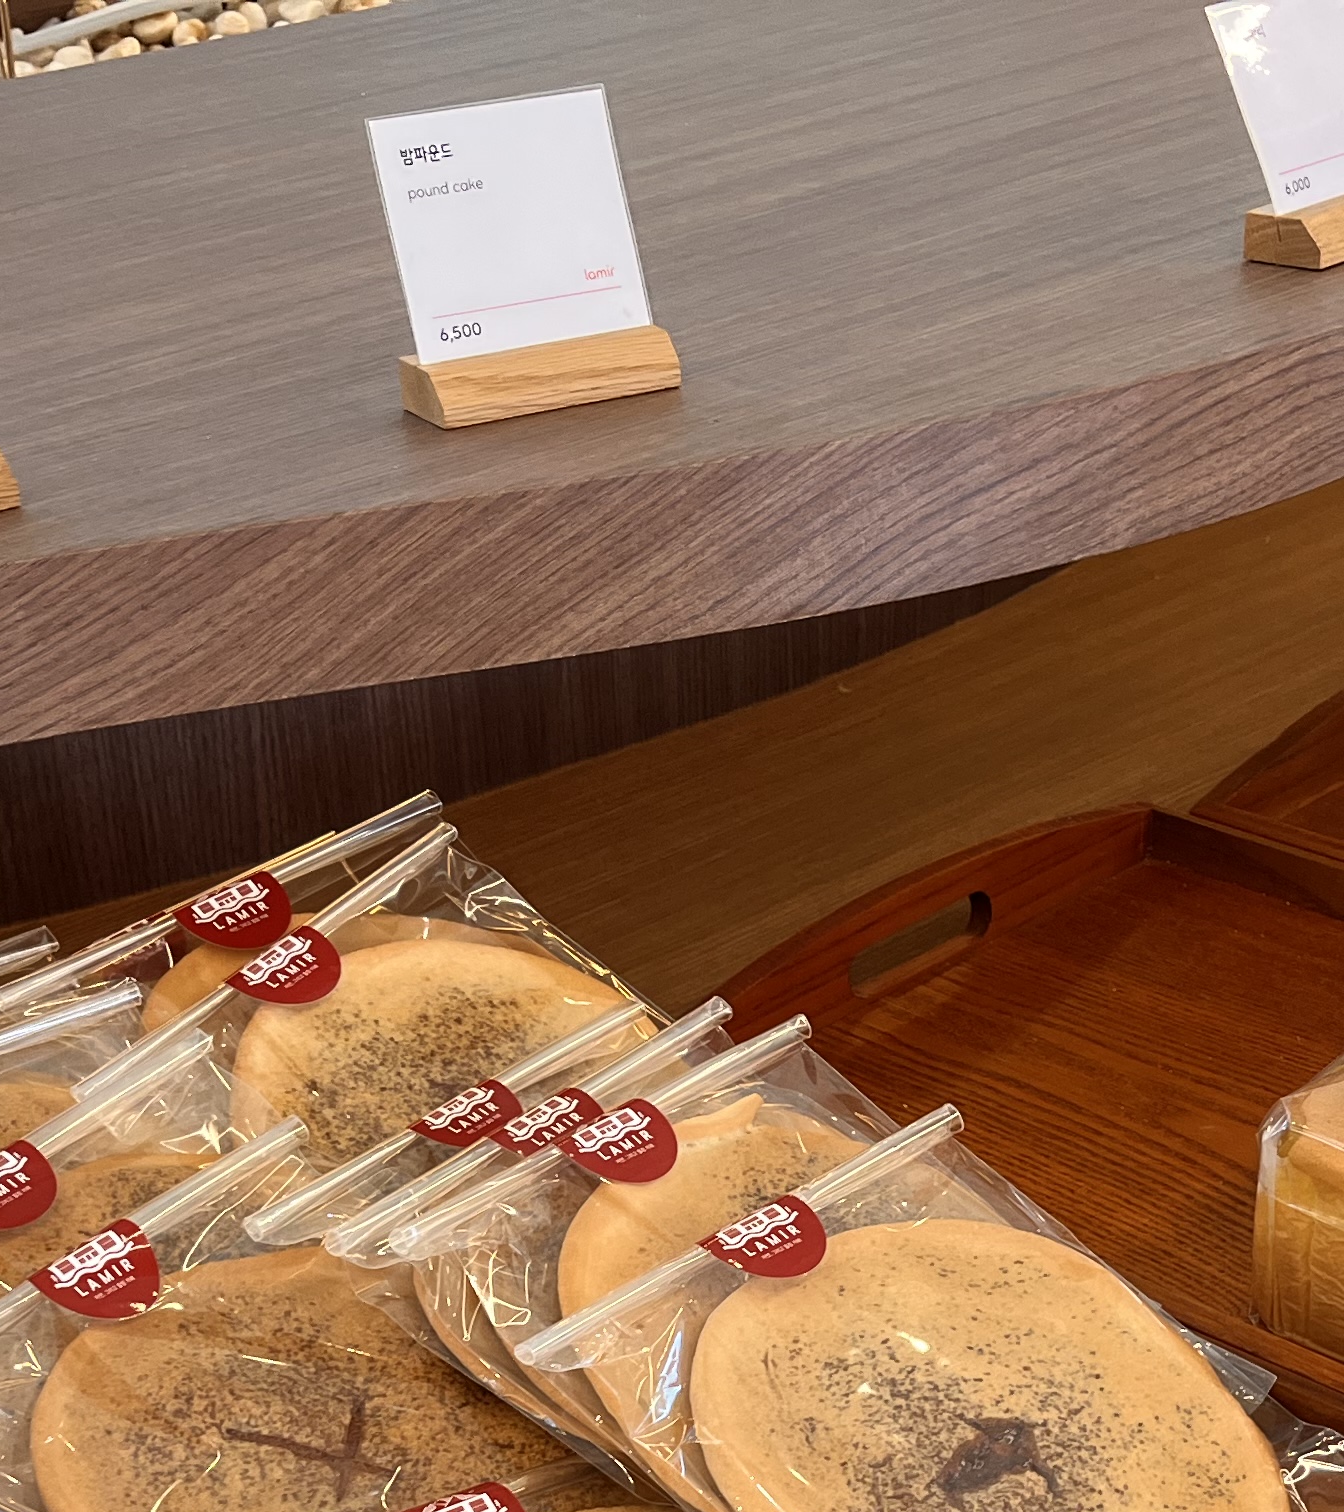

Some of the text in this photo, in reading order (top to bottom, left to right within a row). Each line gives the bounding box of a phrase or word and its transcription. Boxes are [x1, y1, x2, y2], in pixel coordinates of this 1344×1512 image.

[399, 143, 454, 167] 밤파운드
[408, 177, 484, 203] pound cake
[1285, 176, 1311, 195] 6,000
[584, 264, 616, 281] lamir
[439, 322, 483, 343] 6,500
[213, 901, 270, 930] LAMIR
[266, 952, 317, 989] LAMIR
[448, 1102, 500, 1134] LAMIR
[531, 1112, 584, 1147] LAMIR
[597, 1131, 654, 1161] LAMIR
[742, 1224, 802, 1257] LAMIR
[74, 1258, 135, 1298] LAMIR
